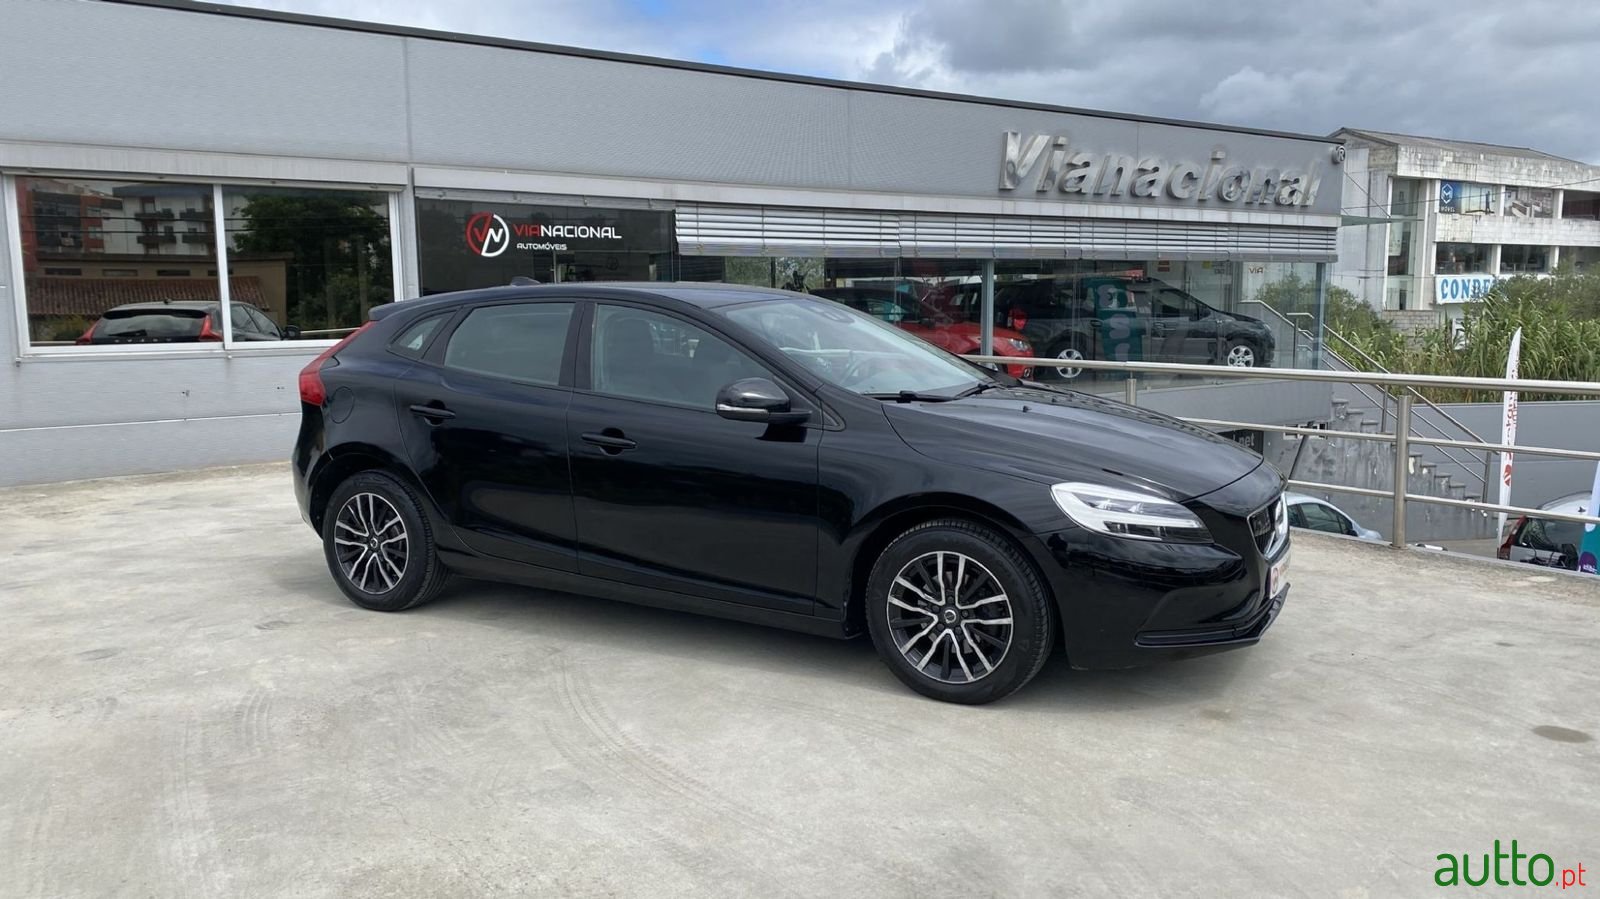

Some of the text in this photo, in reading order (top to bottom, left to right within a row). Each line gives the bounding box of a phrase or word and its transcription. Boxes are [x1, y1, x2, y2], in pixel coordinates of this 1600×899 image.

[999, 130, 1321, 207] Vianacional
[512, 223, 622, 239] VIANACIONAL
[516, 242, 567, 251] AUTOMÓVEIS
